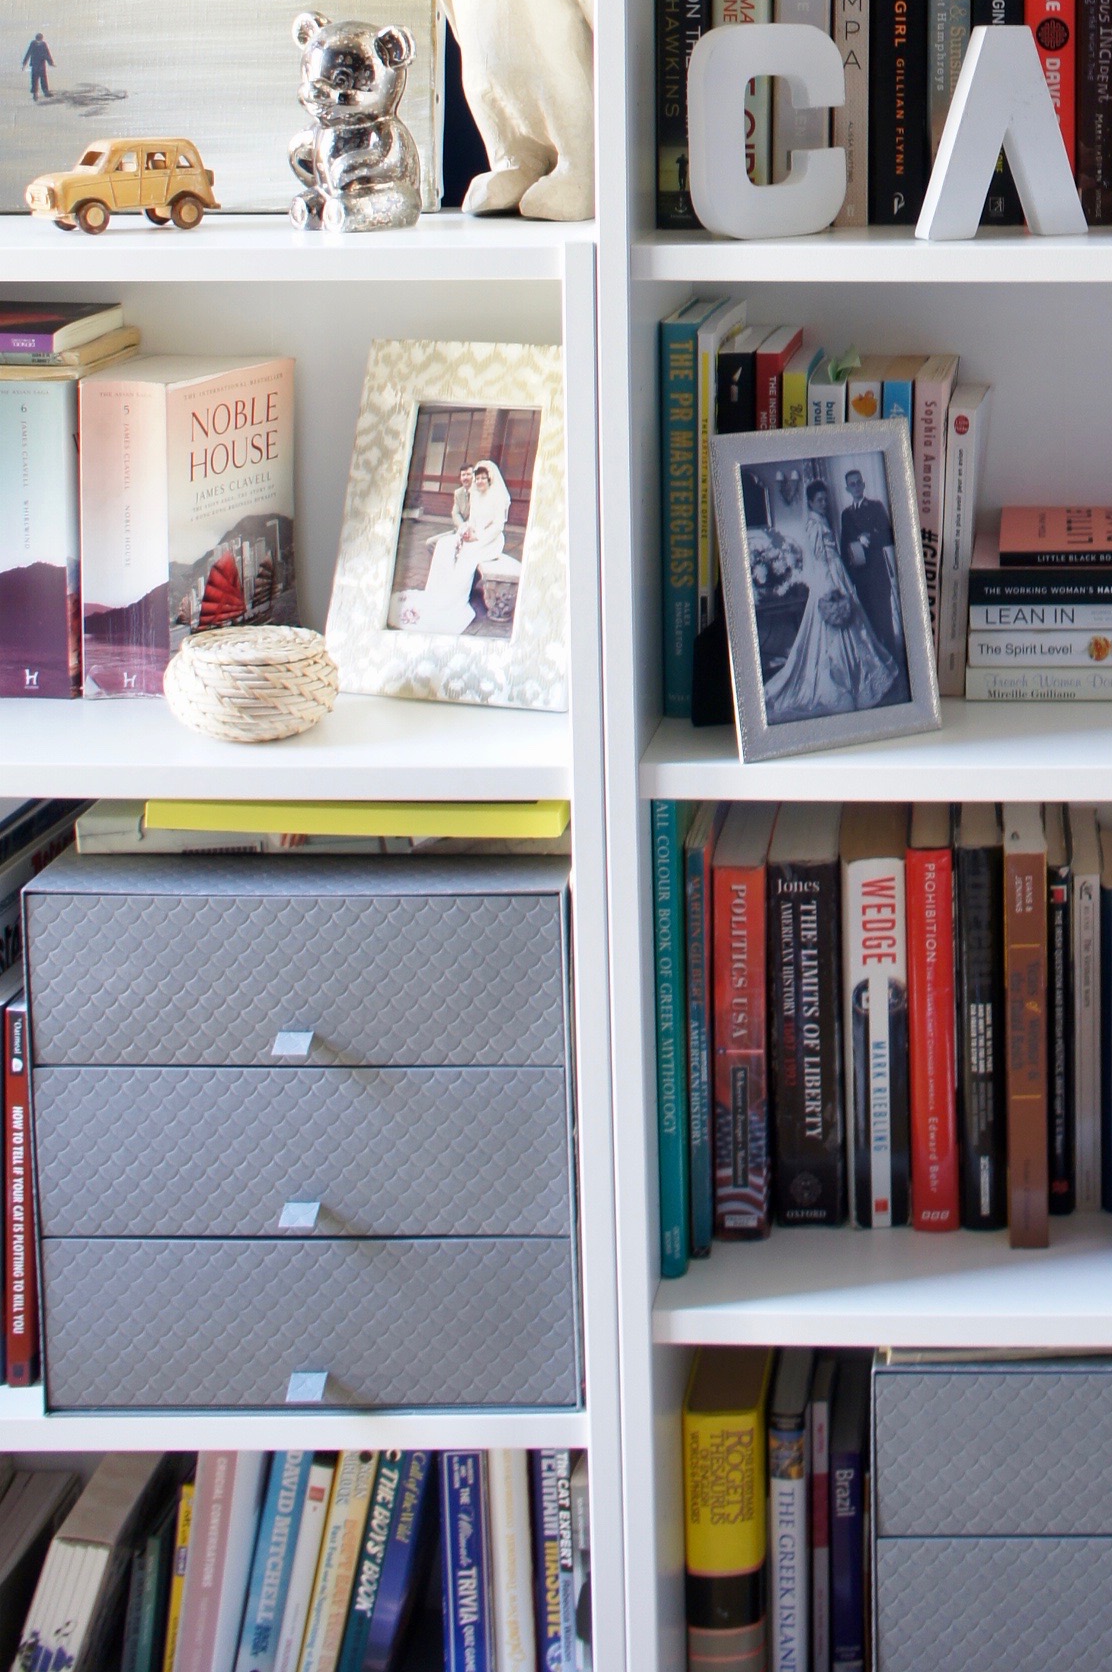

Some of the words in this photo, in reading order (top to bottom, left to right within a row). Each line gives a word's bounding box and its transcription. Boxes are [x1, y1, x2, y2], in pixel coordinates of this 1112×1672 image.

[894, 0, 907, 47] GIRL
[896, 58, 906, 118] GILLIAN
[686, 22, 846, 240] C
[896, 127, 905, 175] FLYNN
[914, 24, 1088, 241] A
[669, 340, 693, 381] THE
[190, 391, 279, 443] NOBLE
[669, 390, 693, 421] PR
[189, 429, 279, 483] HOUSE
[668, 428, 693, 590] MASTERCLASS
[984, 586, 1000, 595] THE
[1004, 586, 1047, 595] WORKING
[1050, 586, 1094, 595] WOMAN'S
[985, 608, 1048, 626] LEAN
[1053, 607, 1075, 625] IN
[977, 643, 1002, 656] The
[1005, 643, 1035, 659] Spirit
[1038, 643, 1073, 656] Level
[776, 877, 820, 895] Jones
[801, 900, 819, 942] THE
[860, 876, 897, 967] WEDGE
[924, 862, 936, 962] PROHIBITION
[729, 883, 747, 996] POLITICS
[802, 948, 819, 1018] LIMITS
[731, 1000, 747, 1041] USA
[803, 1023, 820, 1051] OF
[871, 1040, 886, 1083] MARK
[12, 1106, 24, 1130] HOW
[803, 1056, 822, 1142] LIBERTY
[873, 1086, 888, 1153] RIEBLING
[12, 1132, 24, 1145] TO
[12, 1146, 24, 1165] TELL
[12, 1167, 24, 1175] IF
[12, 1177, 24, 1202] YOUR
[12, 1204, 24, 1222] CAT
[12, 1224, 24, 1232] IS
[12, 1234, 24, 1278] PLOTTING
[12, 1279, 24, 1292] TO
[13, 1294, 24, 1313] KILL
[13, 1315, 24, 1335] YOU
[778, 1489, 795, 1524] THE
[836, 1469, 856, 1518] Brazil
[779, 1533, 796, 1601] GREEK
[457, 1567, 477, 1625] TRIVIA
